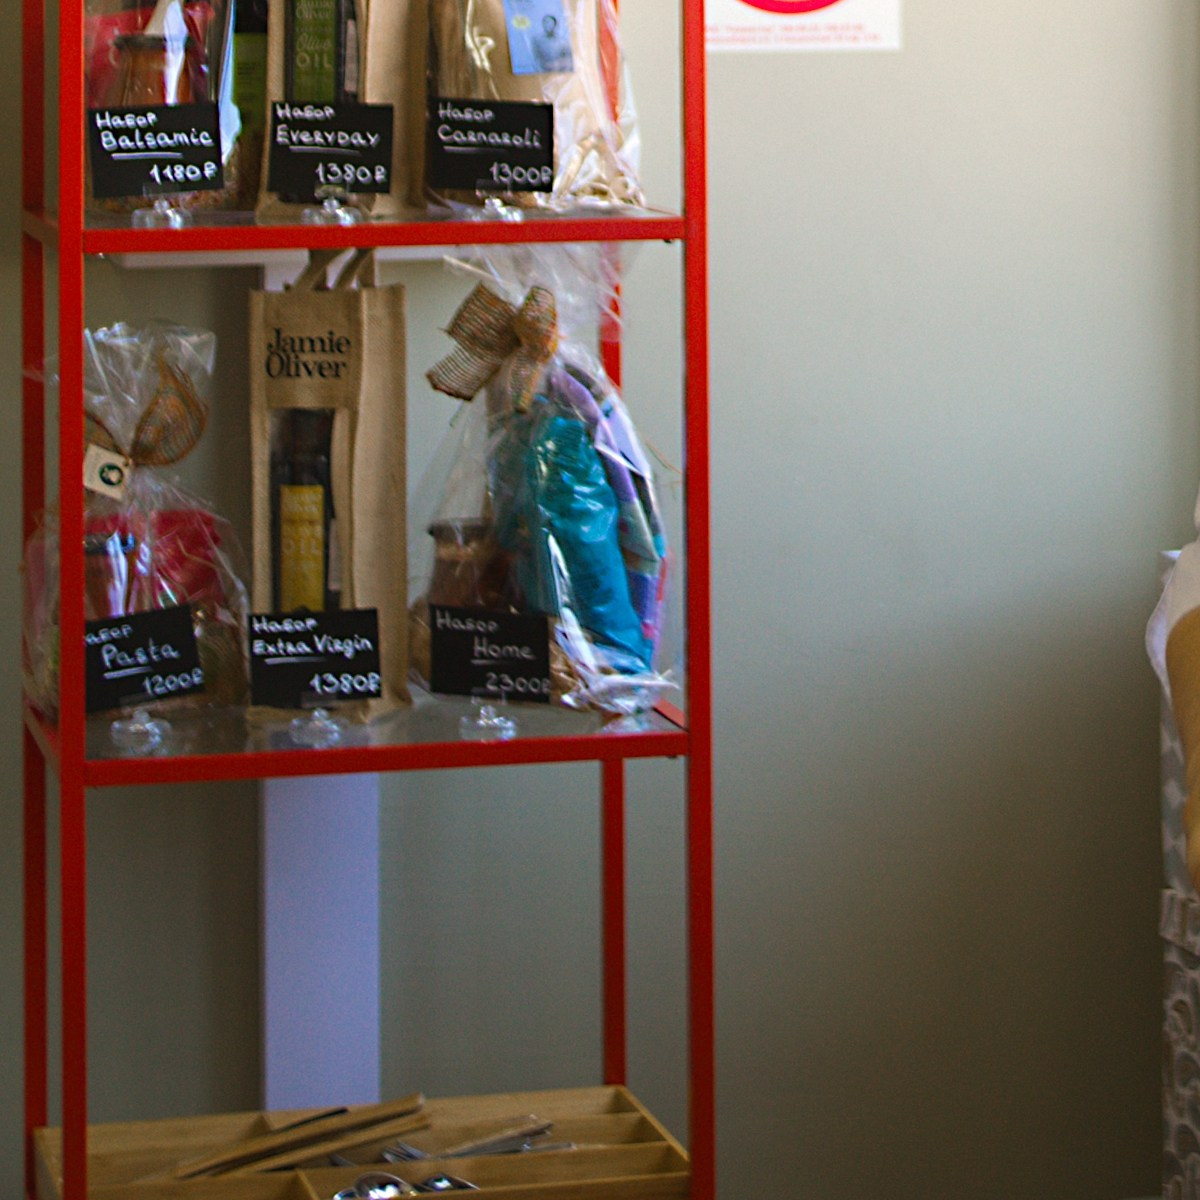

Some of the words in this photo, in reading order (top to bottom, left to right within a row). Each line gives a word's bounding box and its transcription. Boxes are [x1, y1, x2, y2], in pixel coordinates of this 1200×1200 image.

[100, 128, 214, 151] Balsamic
[266, 327, 351, 354] Jamie
[265, 351, 347, 379] Oliver
[84, 624, 132, 646] абор
[101, 637, 181, 669] Pasta
[473, 636, 536, 660] Home
